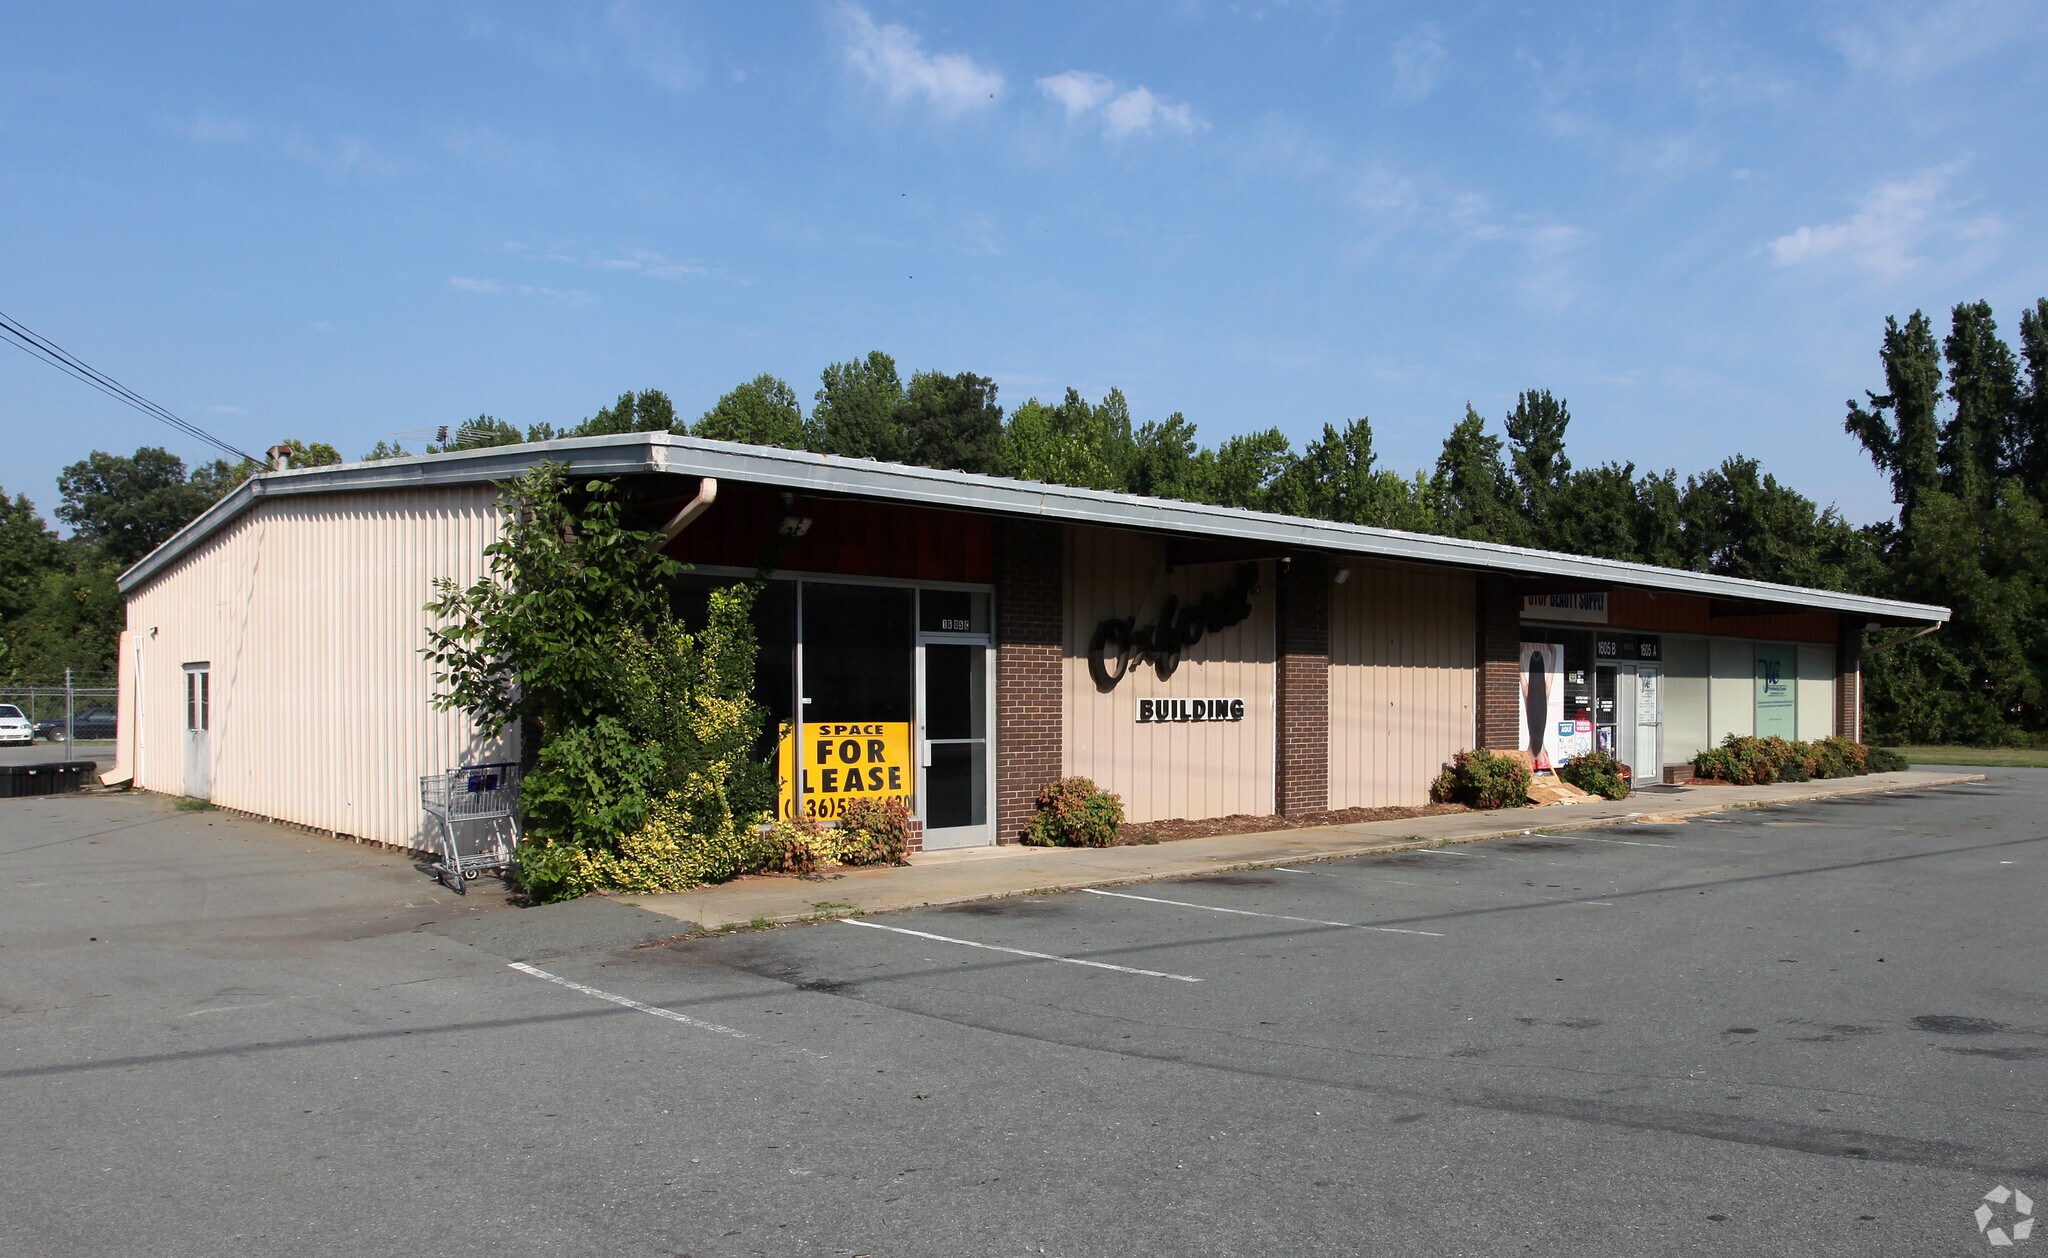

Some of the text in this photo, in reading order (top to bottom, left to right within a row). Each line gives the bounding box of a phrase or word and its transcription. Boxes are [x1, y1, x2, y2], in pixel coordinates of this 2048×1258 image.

[1580, 593, 1604, 611] SUPPLY
[1598, 641, 1611, 655] 1605
[1641, 643, 1652, 657] 1605
[1140, 699, 1244, 722] BUILDING
[819, 725, 884, 736] SPACE
[816, 739, 886, 765] FOR
[802, 766, 902, 794] LEASE
